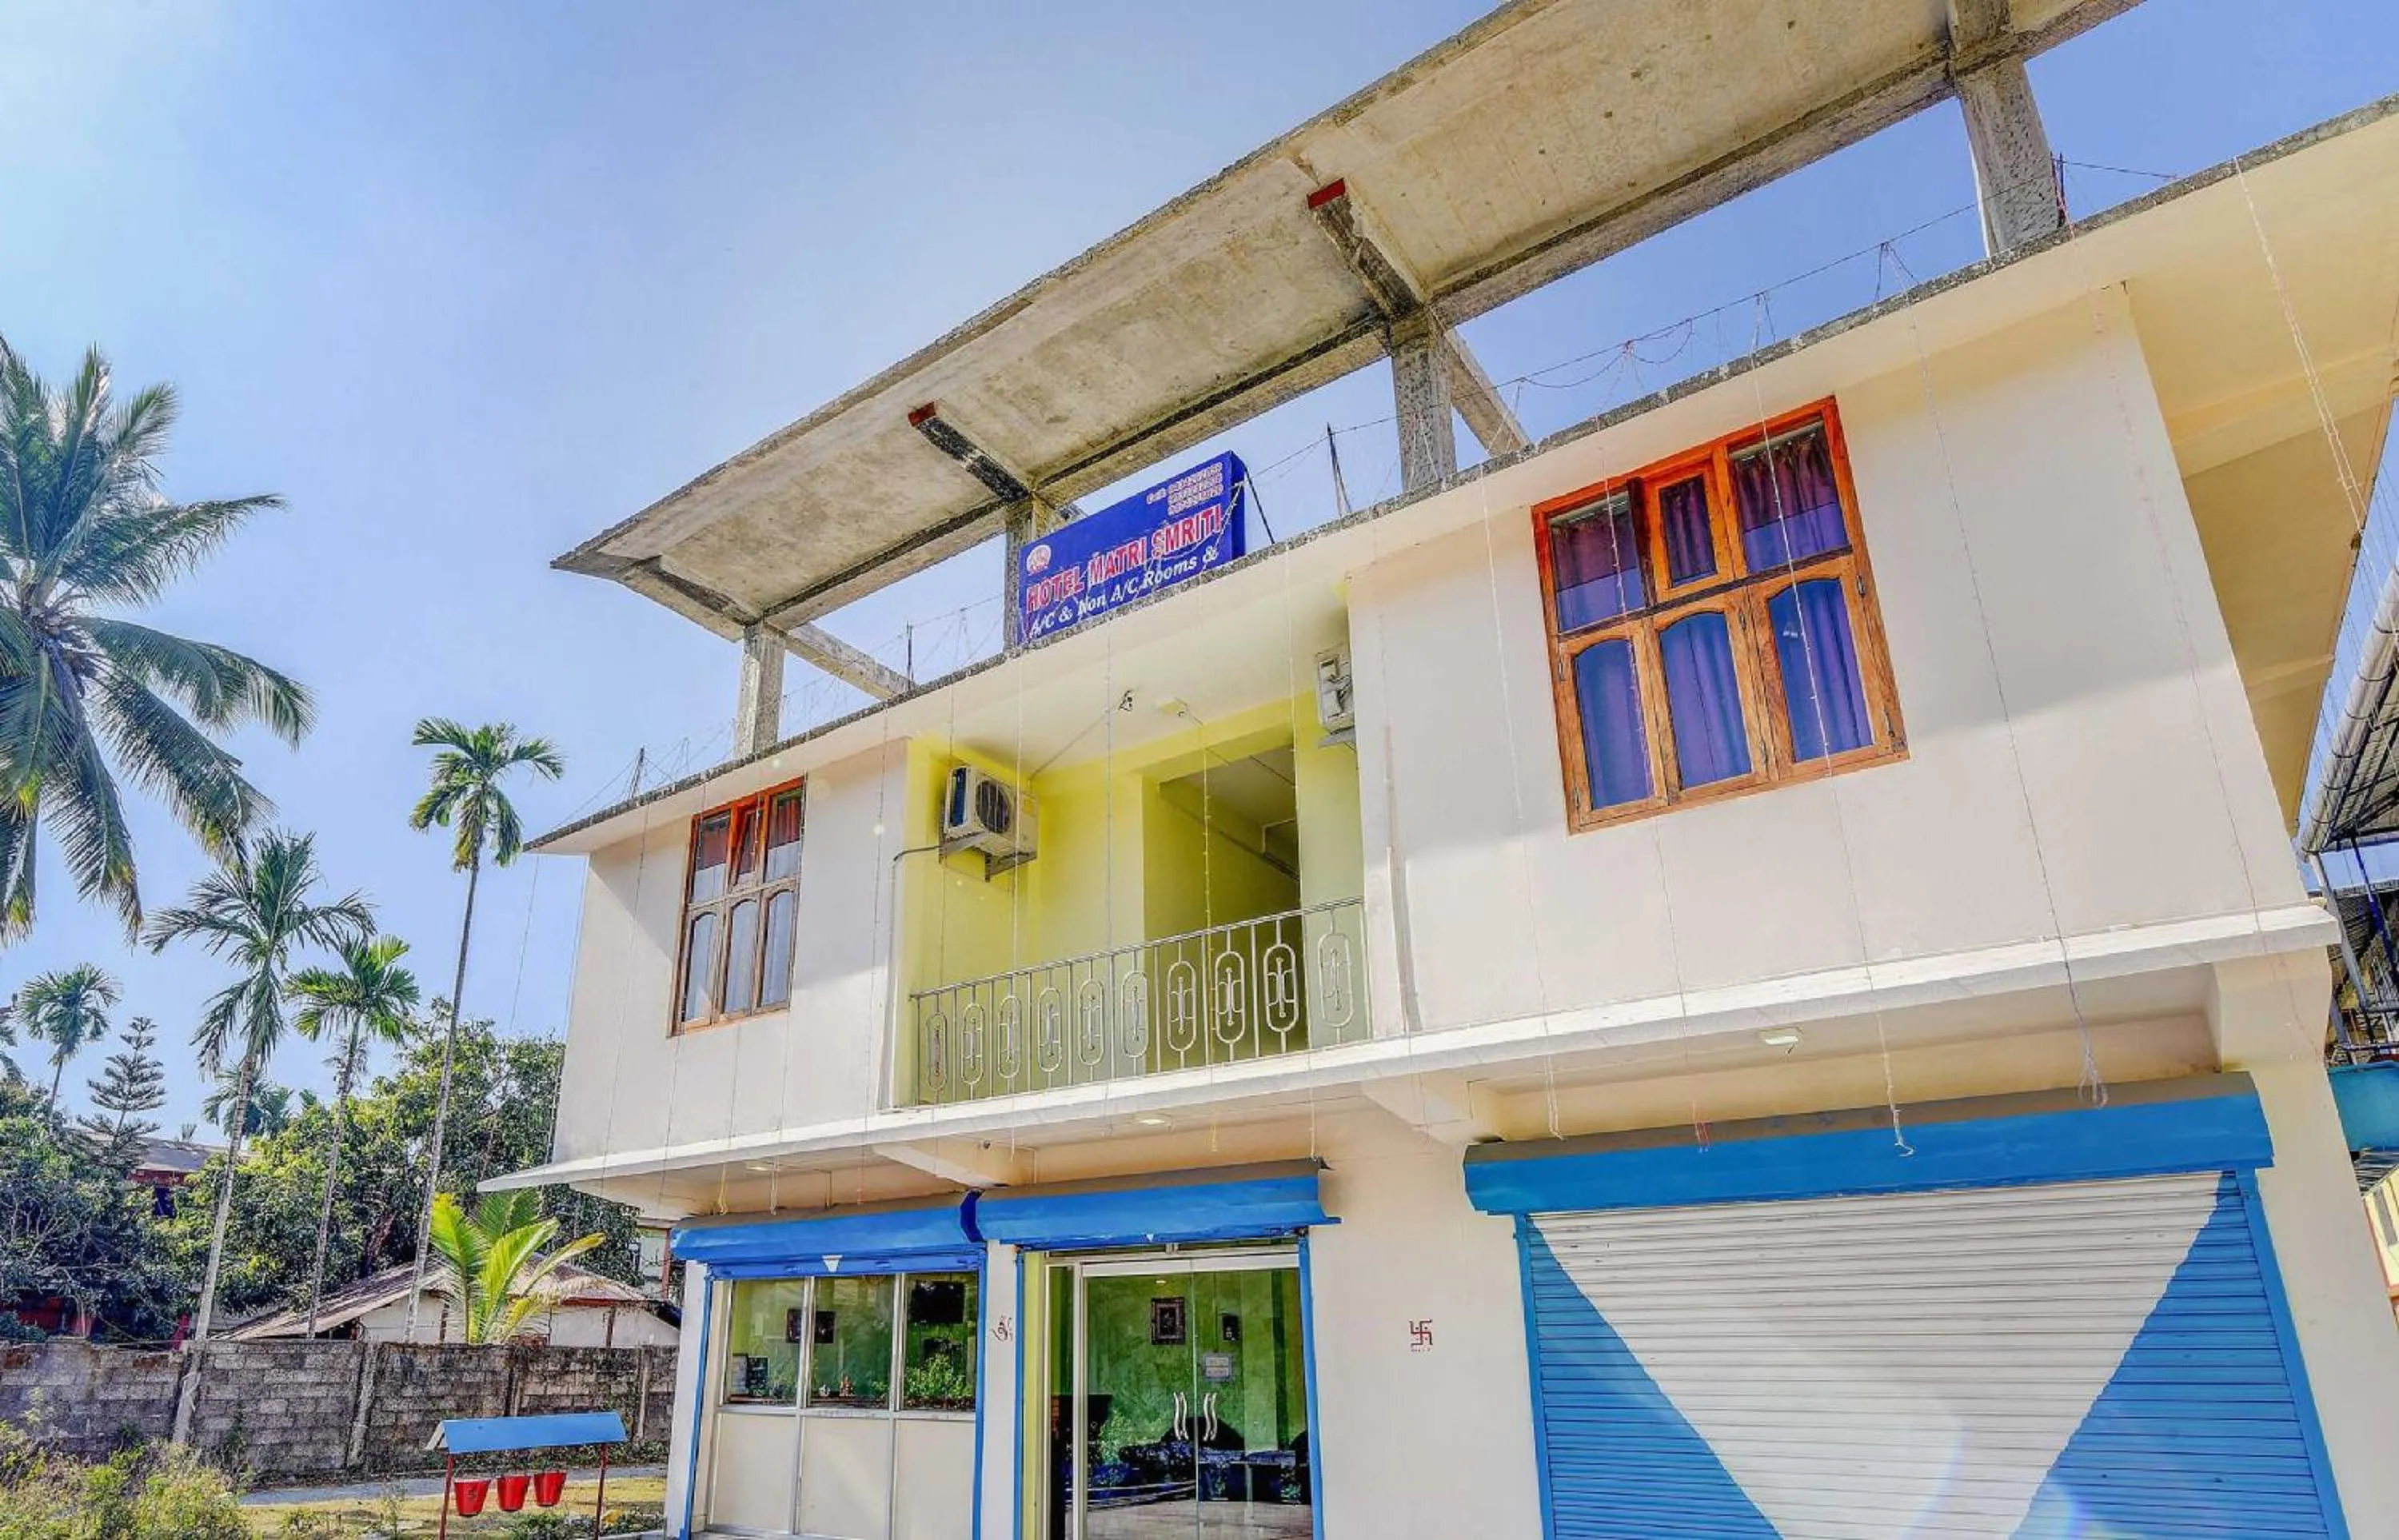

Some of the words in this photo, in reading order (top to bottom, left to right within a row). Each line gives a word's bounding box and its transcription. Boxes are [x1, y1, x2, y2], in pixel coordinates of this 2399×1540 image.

[1026, 566, 1085, 614] HOTEL
[1088, 537, 1148, 588] MATRI
[1152, 503, 1221, 559] SMRITI
[1029, 613, 1055, 638] A/C
[1059, 605, 1073, 623] &
[1078, 594, 1107, 616] Non
[1111, 577, 1139, 601] A/C
[1141, 556, 1198, 588] Rooms
[1202, 545, 1219, 563] &
